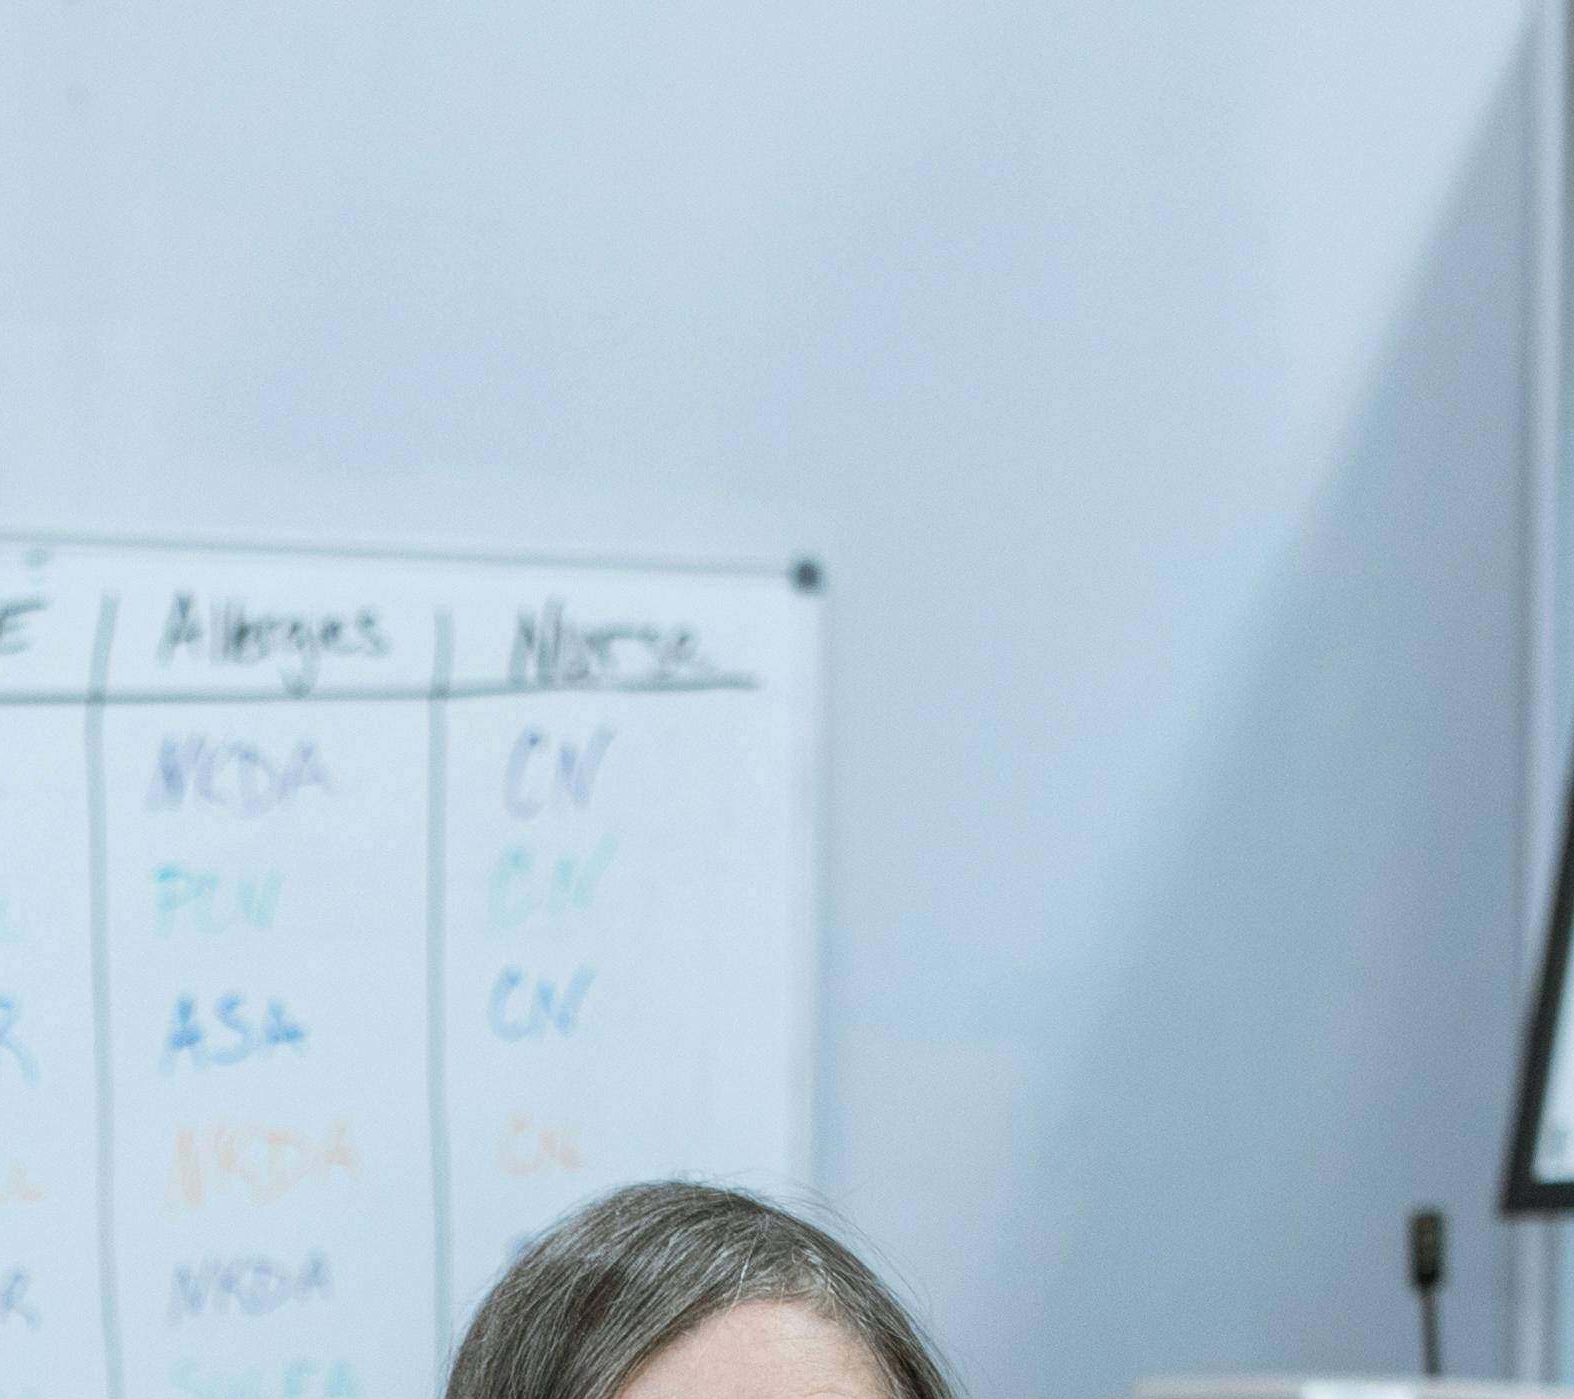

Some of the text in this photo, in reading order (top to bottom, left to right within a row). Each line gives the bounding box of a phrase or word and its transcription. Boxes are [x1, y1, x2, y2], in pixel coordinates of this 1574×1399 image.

[502, 721, 619, 820] CN
[157, 990, 308, 1077] ASA
[486, 962, 597, 1043] CN
